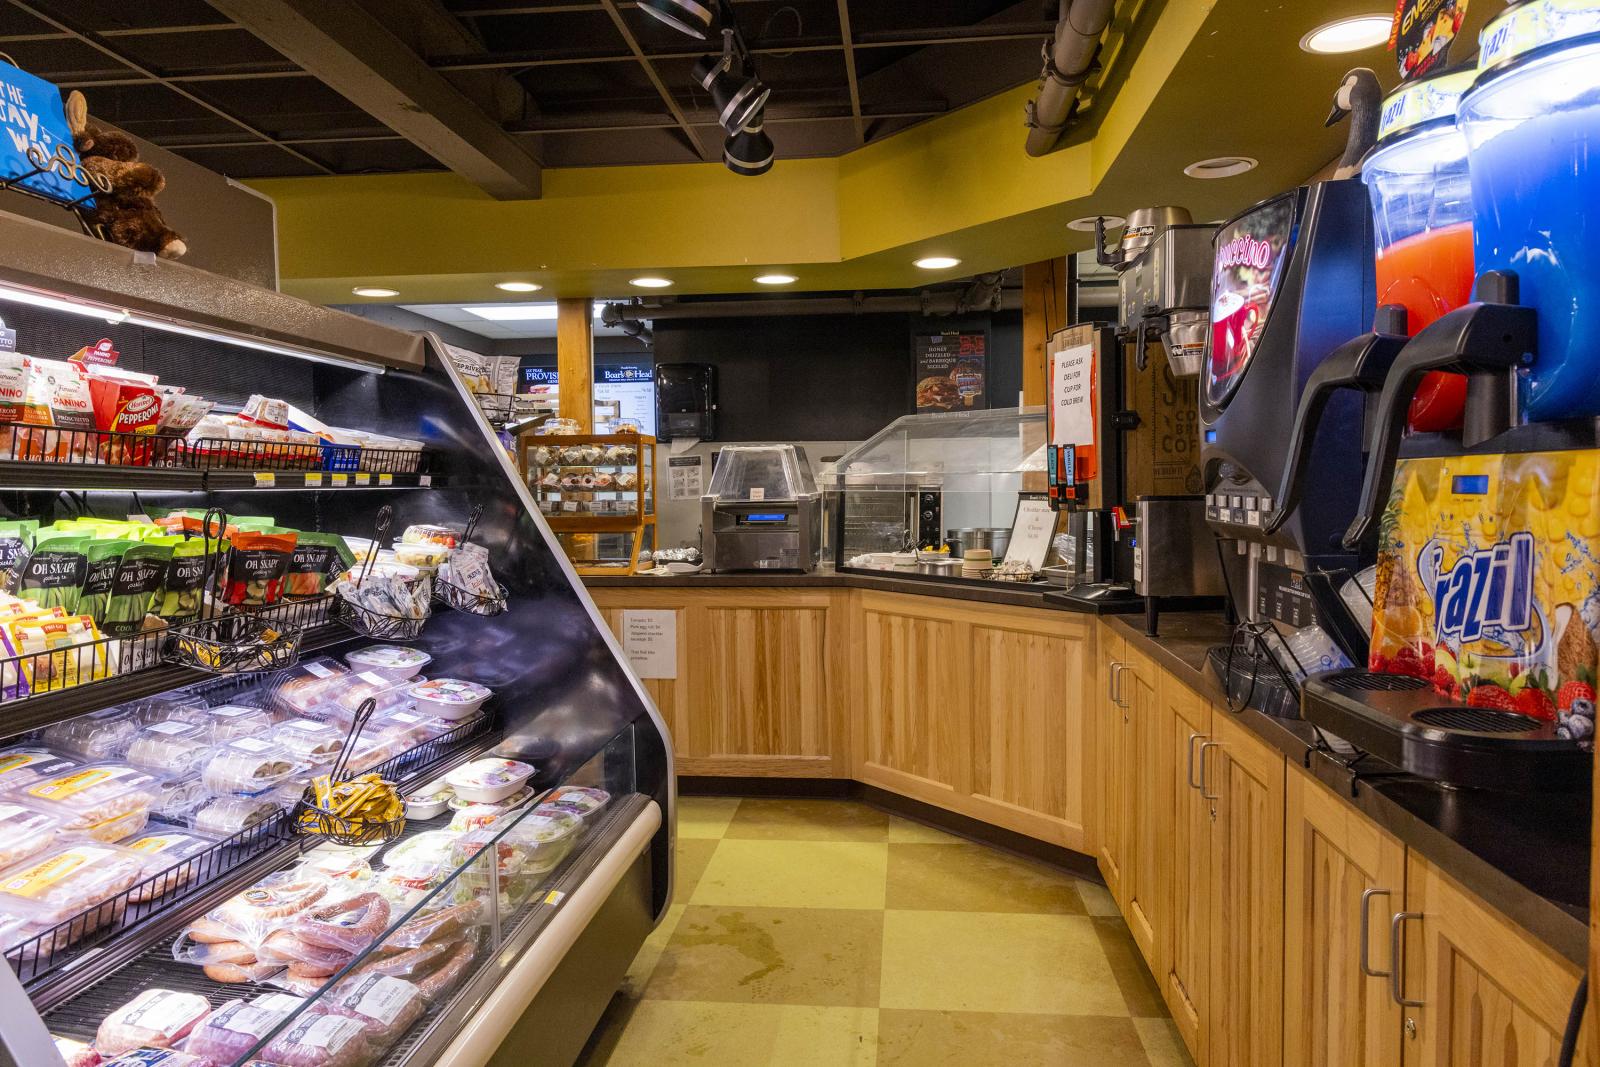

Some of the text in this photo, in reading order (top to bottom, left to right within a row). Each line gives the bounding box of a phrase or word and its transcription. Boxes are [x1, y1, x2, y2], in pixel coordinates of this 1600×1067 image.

[1061, 357, 1083, 369] PLEASE ASK
[605, 369, 653, 379] Boar's Head
[1063, 383, 1081, 394] CUP FOR
[53, 397, 87, 409] PANINO
[1061, 396, 1084, 407] COLD BREW
[119, 403, 158, 424] PEPPERONI
[1162, 435, 1197, 453] COF
[245, 559, 279, 569] OH SNAP!
[294, 554, 306, 563] OH
[32, 561, 76, 575] OH SNAP!
[177, 567, 190, 577] OH
[119, 573, 134, 582] OH
